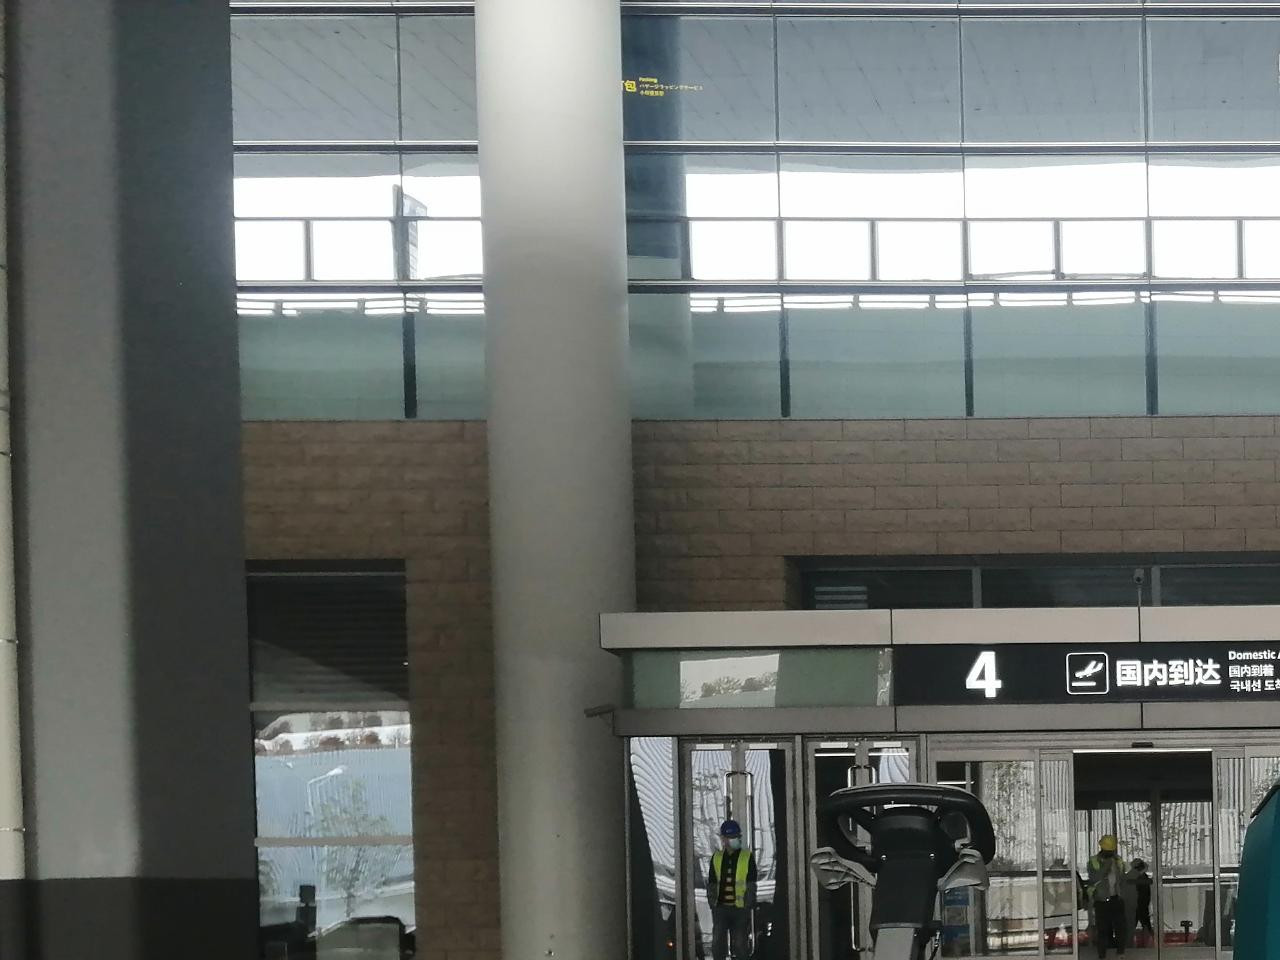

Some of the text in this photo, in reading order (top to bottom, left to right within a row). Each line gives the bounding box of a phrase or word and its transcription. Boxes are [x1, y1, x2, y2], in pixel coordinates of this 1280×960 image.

[1228, 650, 1276, 661] Domestic
[964, 650, 1002, 698] 4
[1116, 658, 1222, 687] 国内到达
[1228, 664, 1275, 678] 国内到着
[1229, 679, 1262, 692] 국내선
